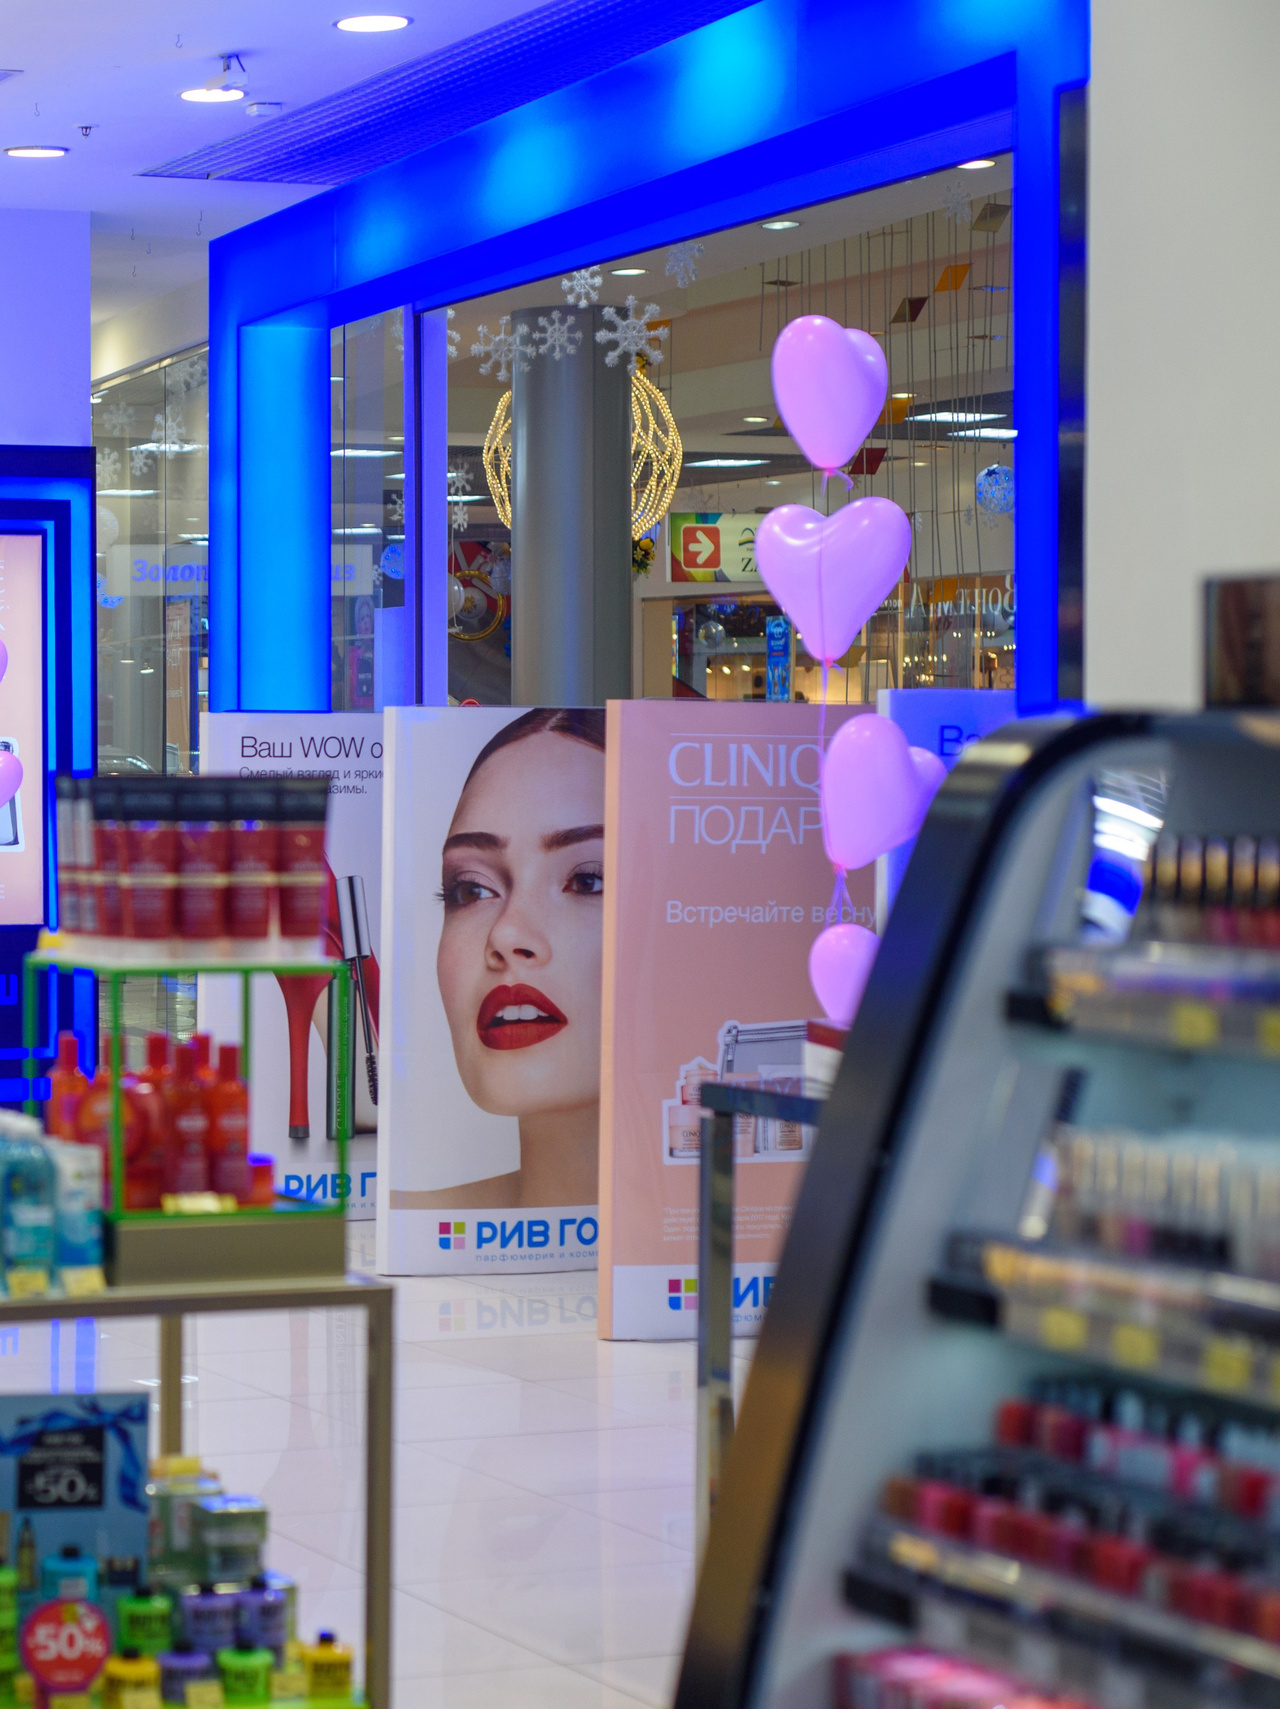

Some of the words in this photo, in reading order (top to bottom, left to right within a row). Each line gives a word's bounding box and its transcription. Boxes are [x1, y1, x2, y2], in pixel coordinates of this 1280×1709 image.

[241, 736, 292, 758] Ваш
[300, 736, 365, 758] WOW
[666, 900, 804, 928] Встречайте
[284, 1173, 351, 1200] РИВ
[476, 1220, 551, 1249] РИВ
[559, 1216, 598, 1246] ГО
[476, 1252, 555, 1263] парфюмерия
